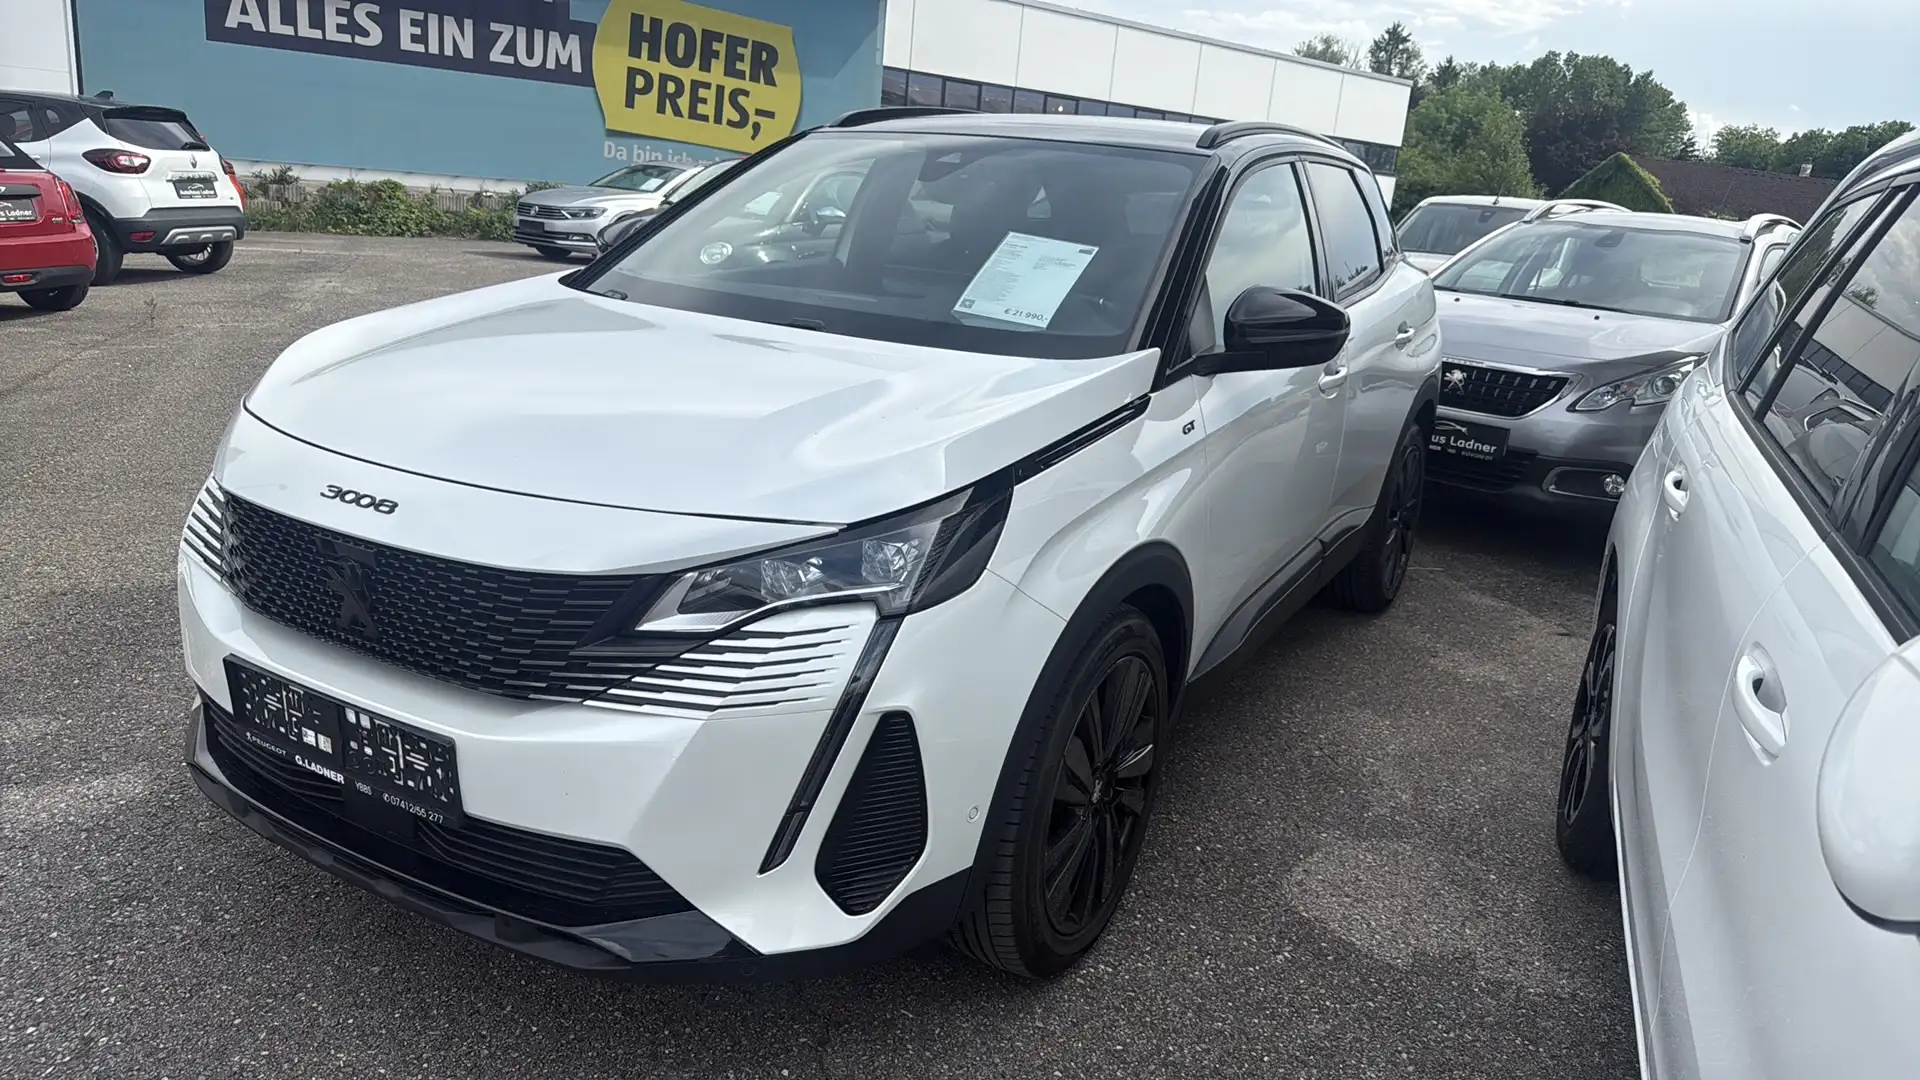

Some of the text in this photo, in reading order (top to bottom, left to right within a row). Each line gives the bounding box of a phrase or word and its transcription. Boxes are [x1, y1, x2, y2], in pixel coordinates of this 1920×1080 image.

[224, 0, 582, 73] ALLES EIN ZUM
[628, 12, 779, 87] HOFER
[624, 66, 776, 141] PREIS,-
[603, 140, 627, 161] Da
[633, 144, 663, 164] bin
[1182, 419, 1196, 435] GT
[1450, 436, 1497, 453] Ladner
[320, 484, 399, 515] 3008
[252, 735, 287, 756] PEUGEOT
[428, 811, 444, 824] 277
